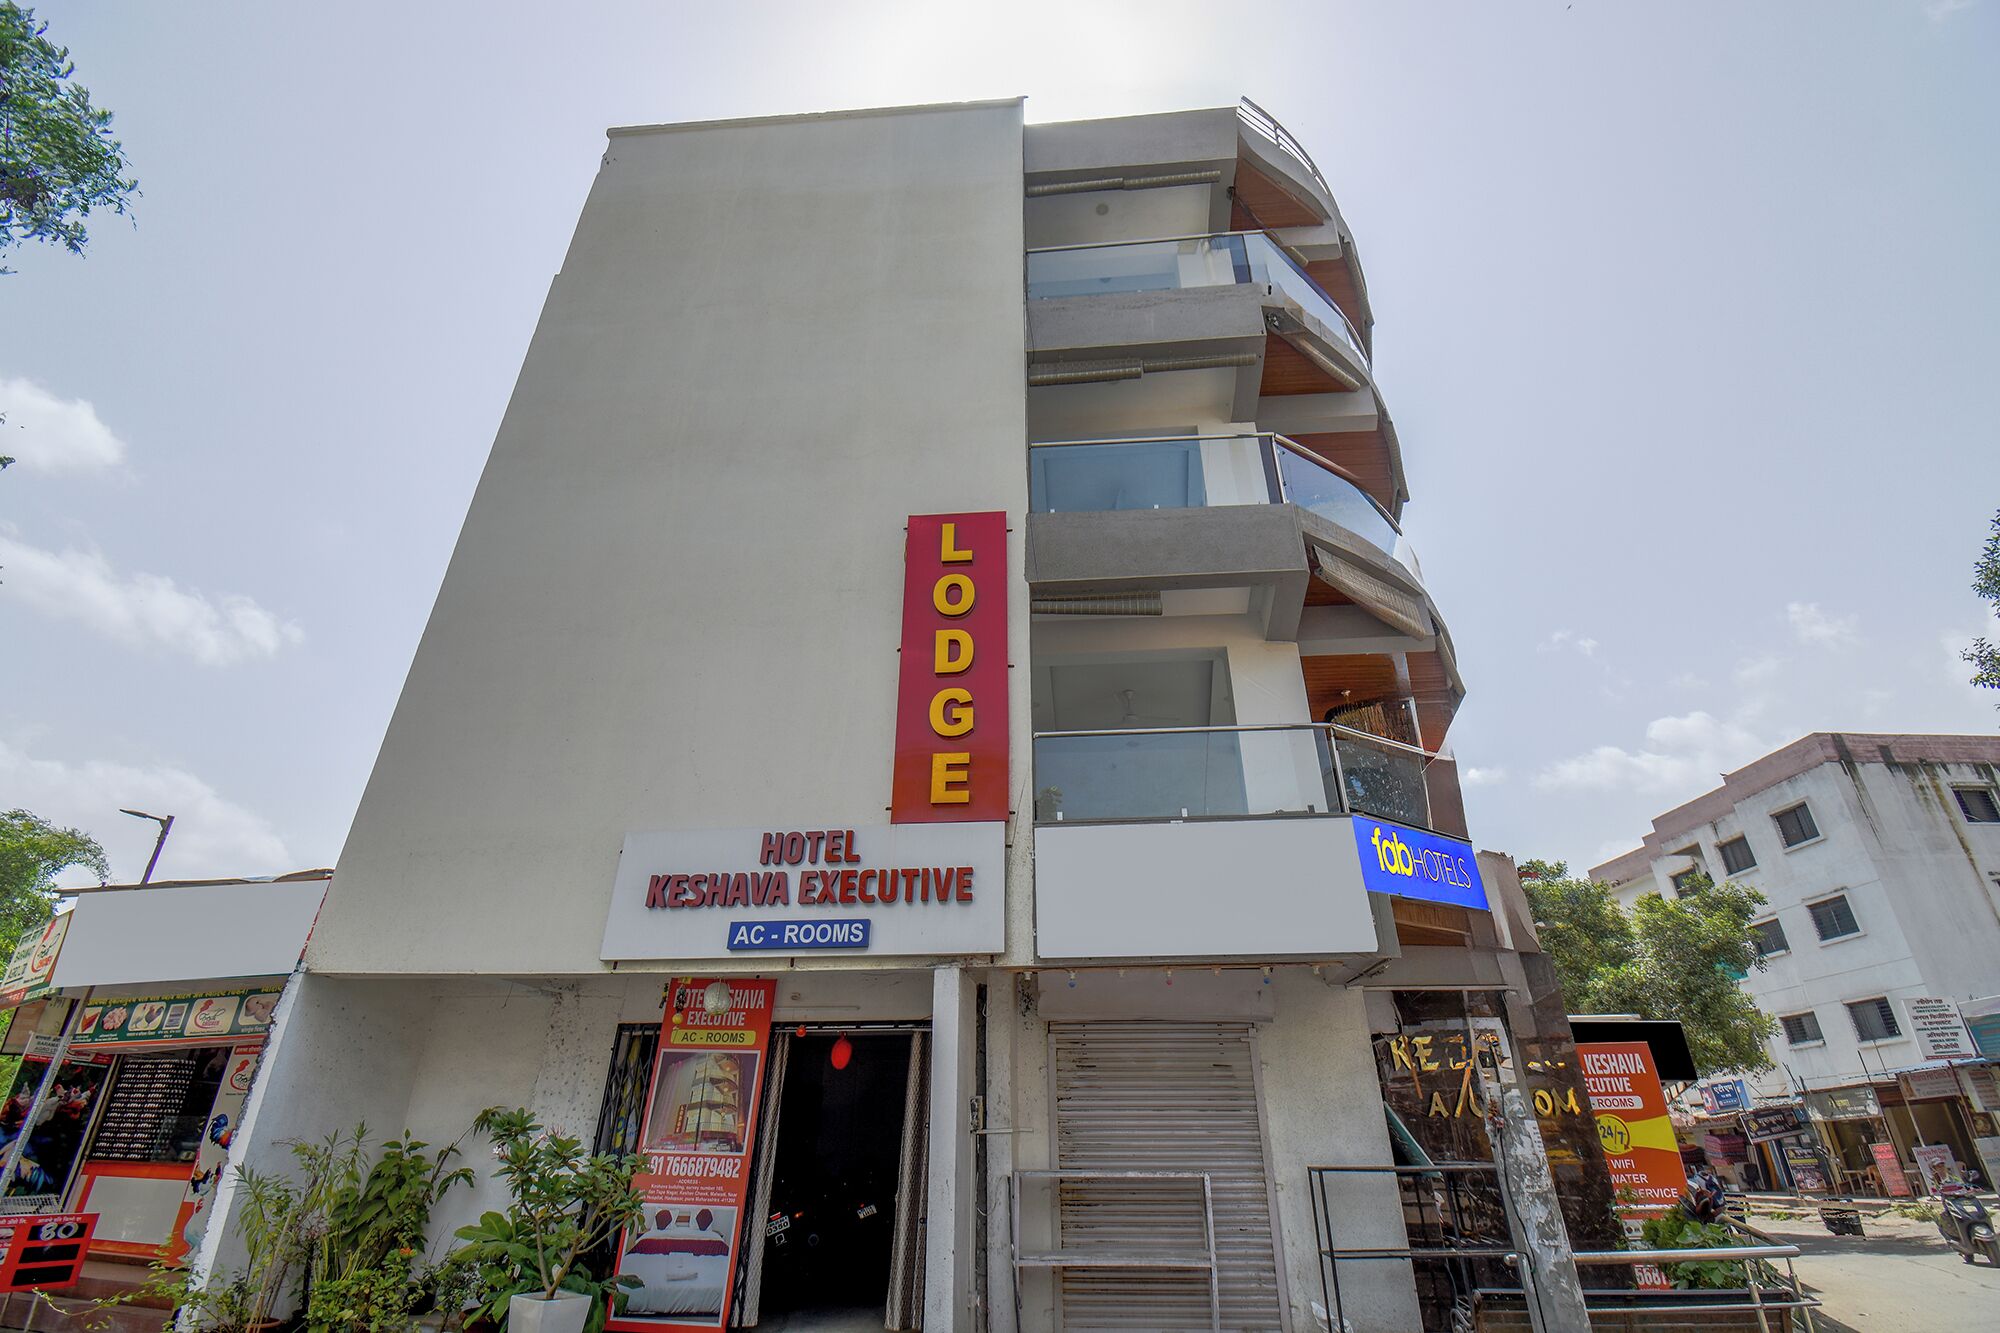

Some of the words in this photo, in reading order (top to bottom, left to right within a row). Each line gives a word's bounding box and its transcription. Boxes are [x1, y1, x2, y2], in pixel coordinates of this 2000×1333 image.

[929, 523, 975, 804] LODGE
[760, 830, 860, 865] HOTEL
[645, 871, 789, 908] KESHAVA
[797, 866, 975, 905] EXECUTIVE
[733, 923, 765, 945] AC
[783, 922, 865, 944] ROOMS
[687, 1011, 746, 1026] EXECUTIVE
[681, 1032, 697, 1042] AC
[706, 1032, 745, 1043] ROOMS
[1583, 1054, 1647, 1074] KESHAVA
[1597, 1098, 1635, 1108] ROOMS
[666, 1156, 741, 1178] 7666879482
[1611, 1159, 1636, 1169] WIFI
[1631, 1187, 1678, 1198] SERVICE
[40, 1222, 79, 1241] 80
